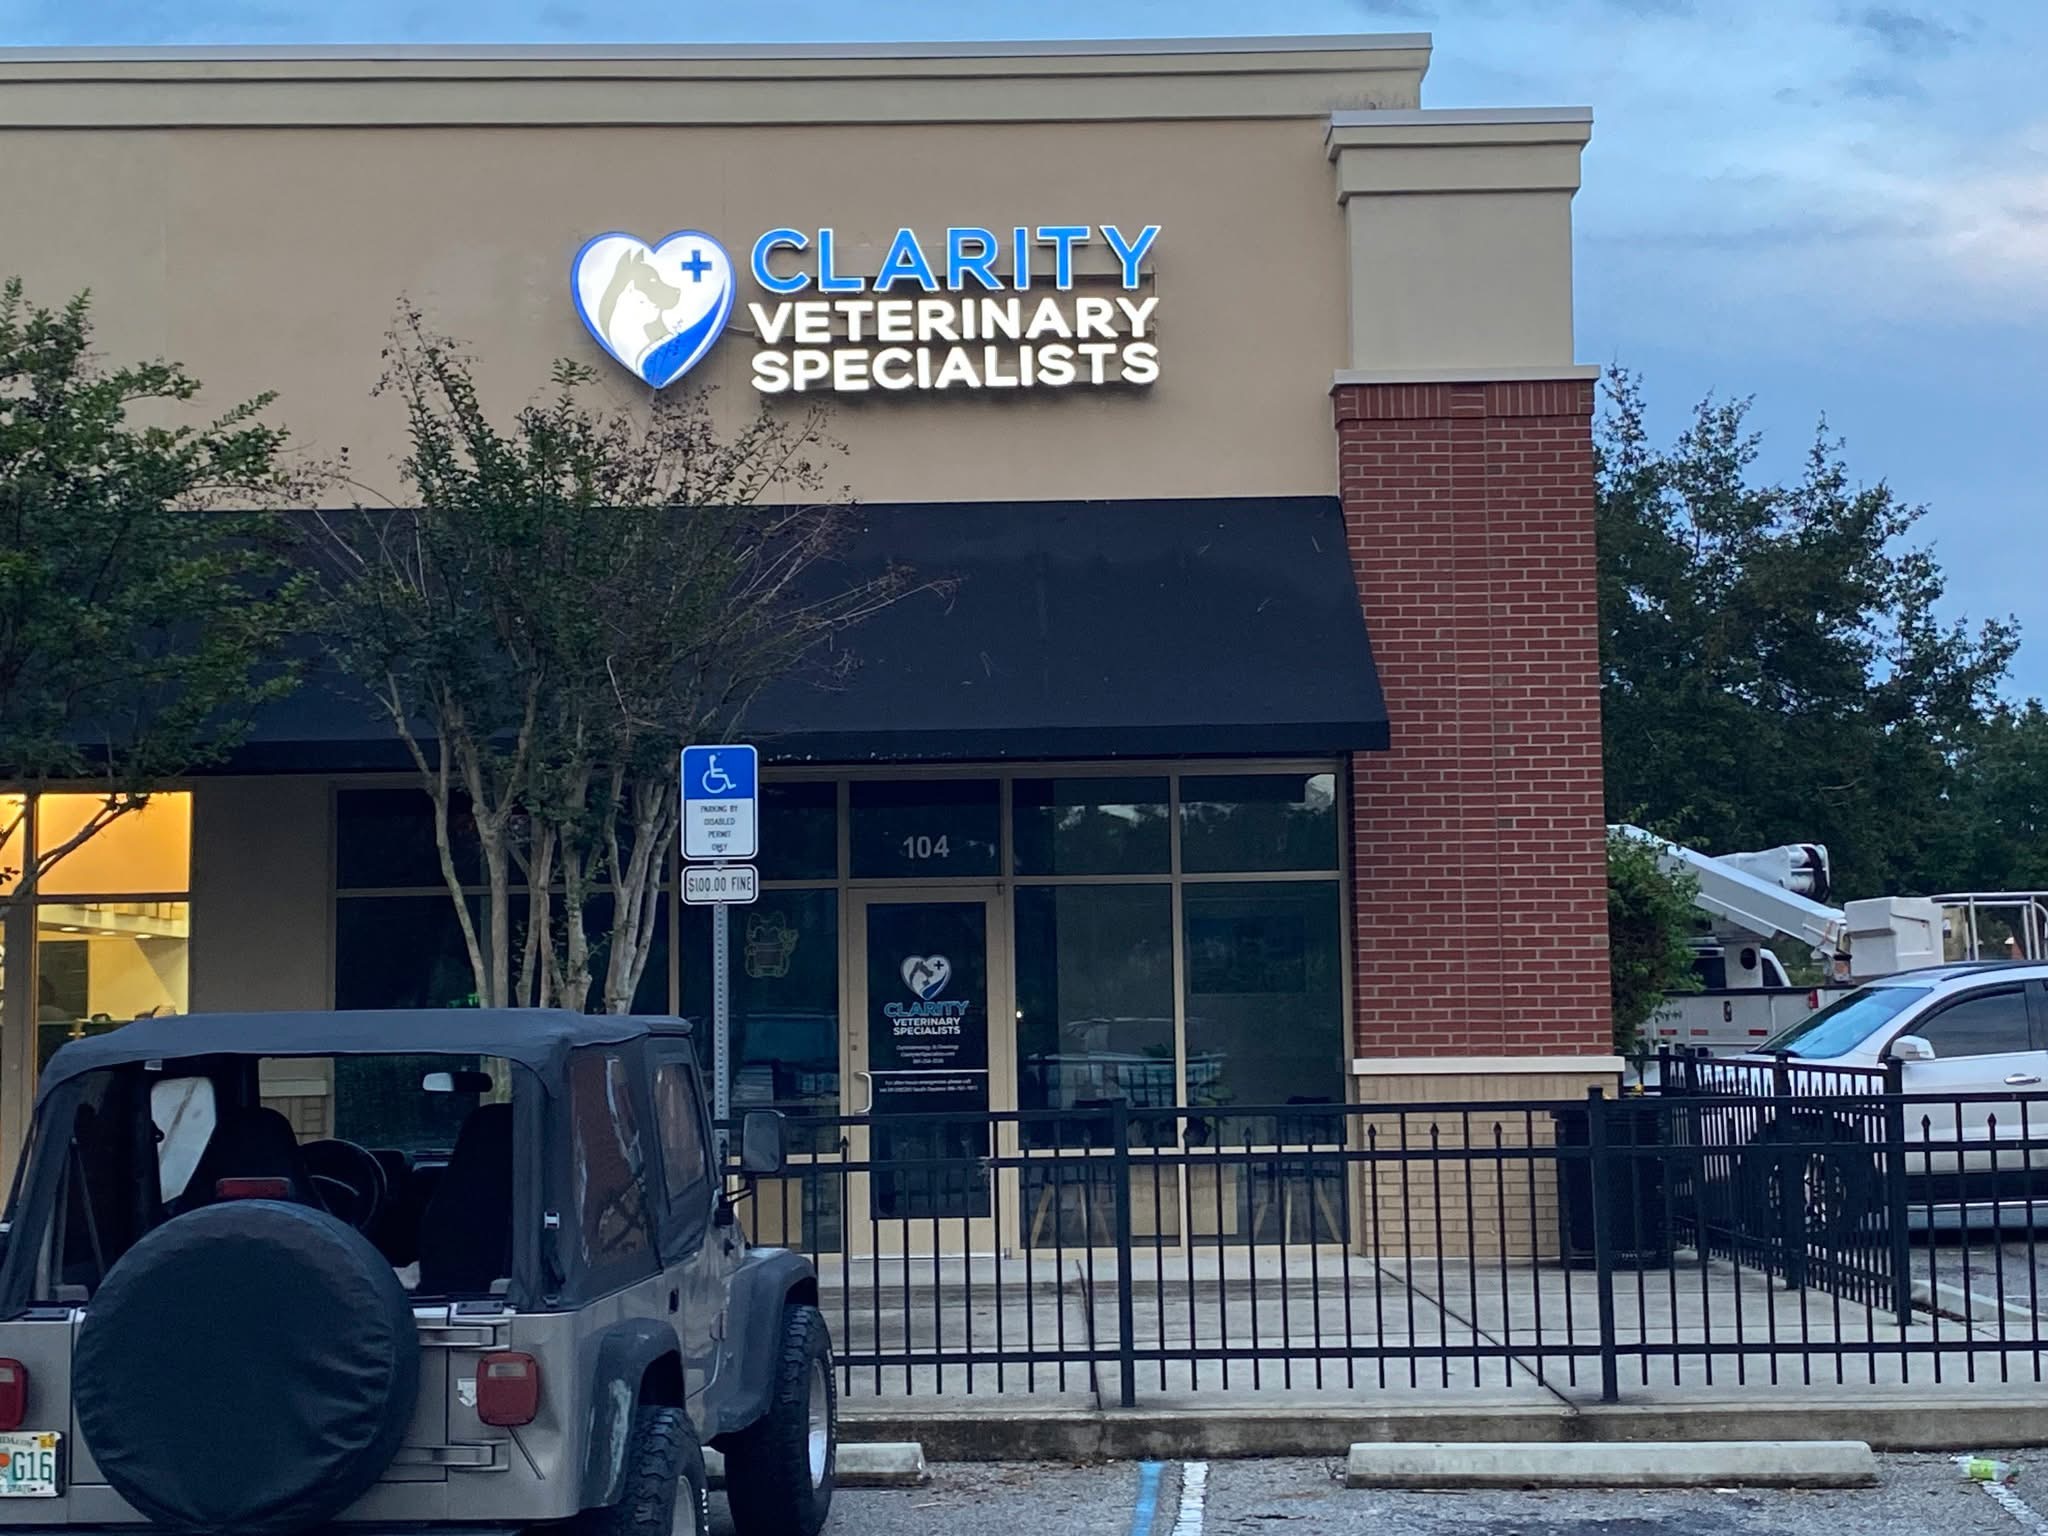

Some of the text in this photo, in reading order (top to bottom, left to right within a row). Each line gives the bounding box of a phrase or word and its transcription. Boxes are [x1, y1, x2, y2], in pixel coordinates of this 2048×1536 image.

[751, 225, 1162, 293] CLARITY
[748, 297, 1160, 344] VETERINARY
[751, 342, 1160, 393] SPECIALISTS
[703, 818, 736, 826] DISABLED
[708, 830, 731, 838] PERMIT
[903, 835, 950, 859] 104
[688, 876, 752, 892] $100.00 FINE
[883, 1000, 970, 1017] CLARITY
[892, 1017, 961, 1026] VETERINARY
[892, 1026, 961, 1035] SPECIALISTS
[12, 1451, 53, 1482] G16
